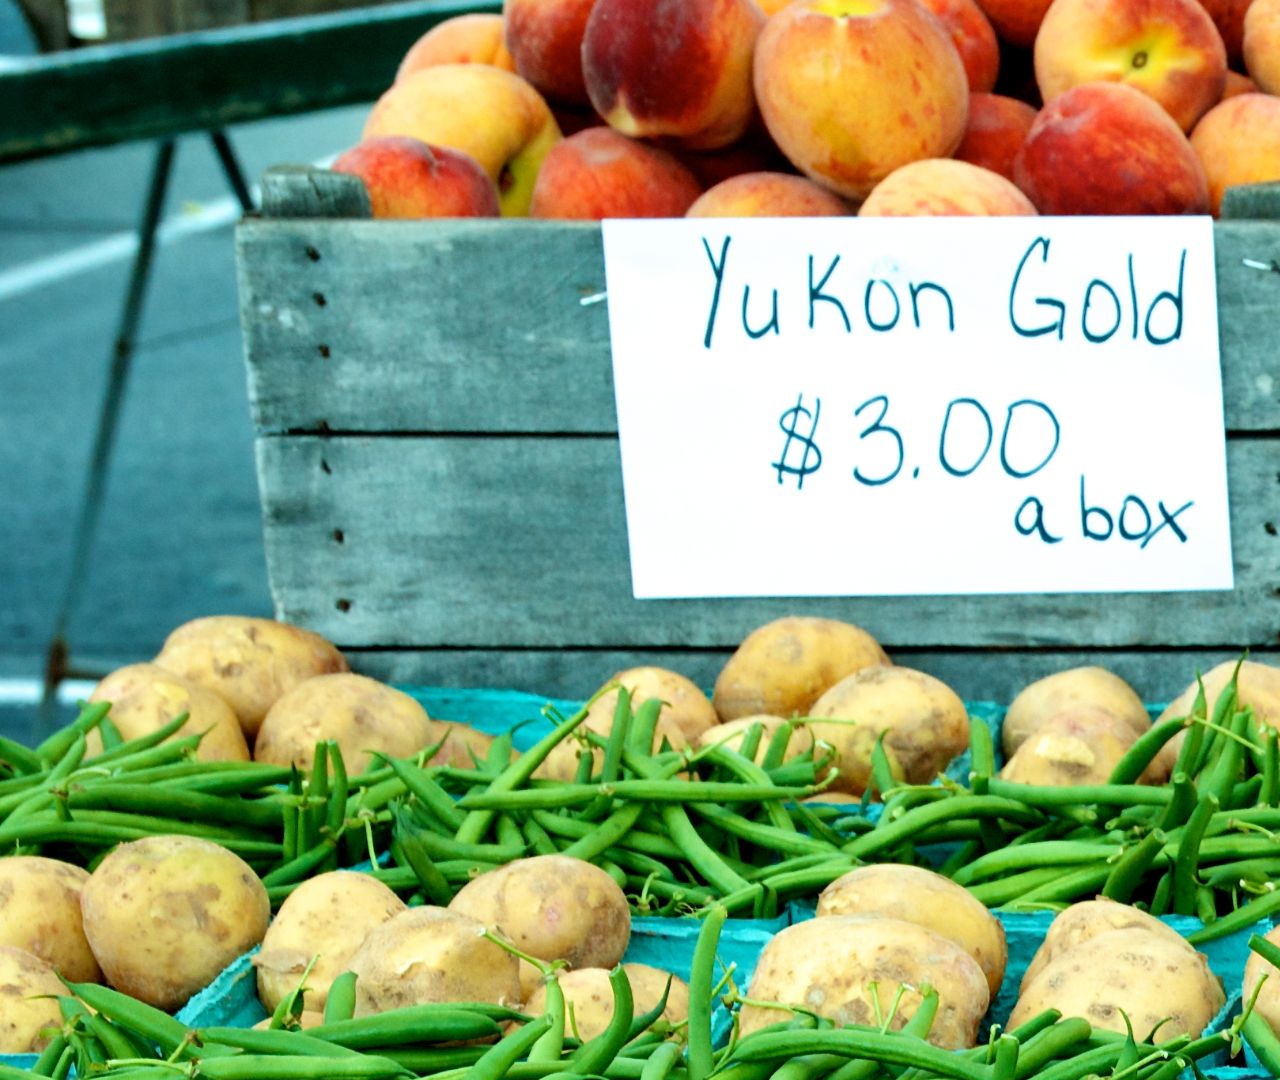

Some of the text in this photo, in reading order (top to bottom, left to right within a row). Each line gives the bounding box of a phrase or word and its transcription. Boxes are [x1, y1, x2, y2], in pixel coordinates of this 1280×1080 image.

[1008, 235, 1187, 346] Gold
[1014, 474, 1195, 550] a box
